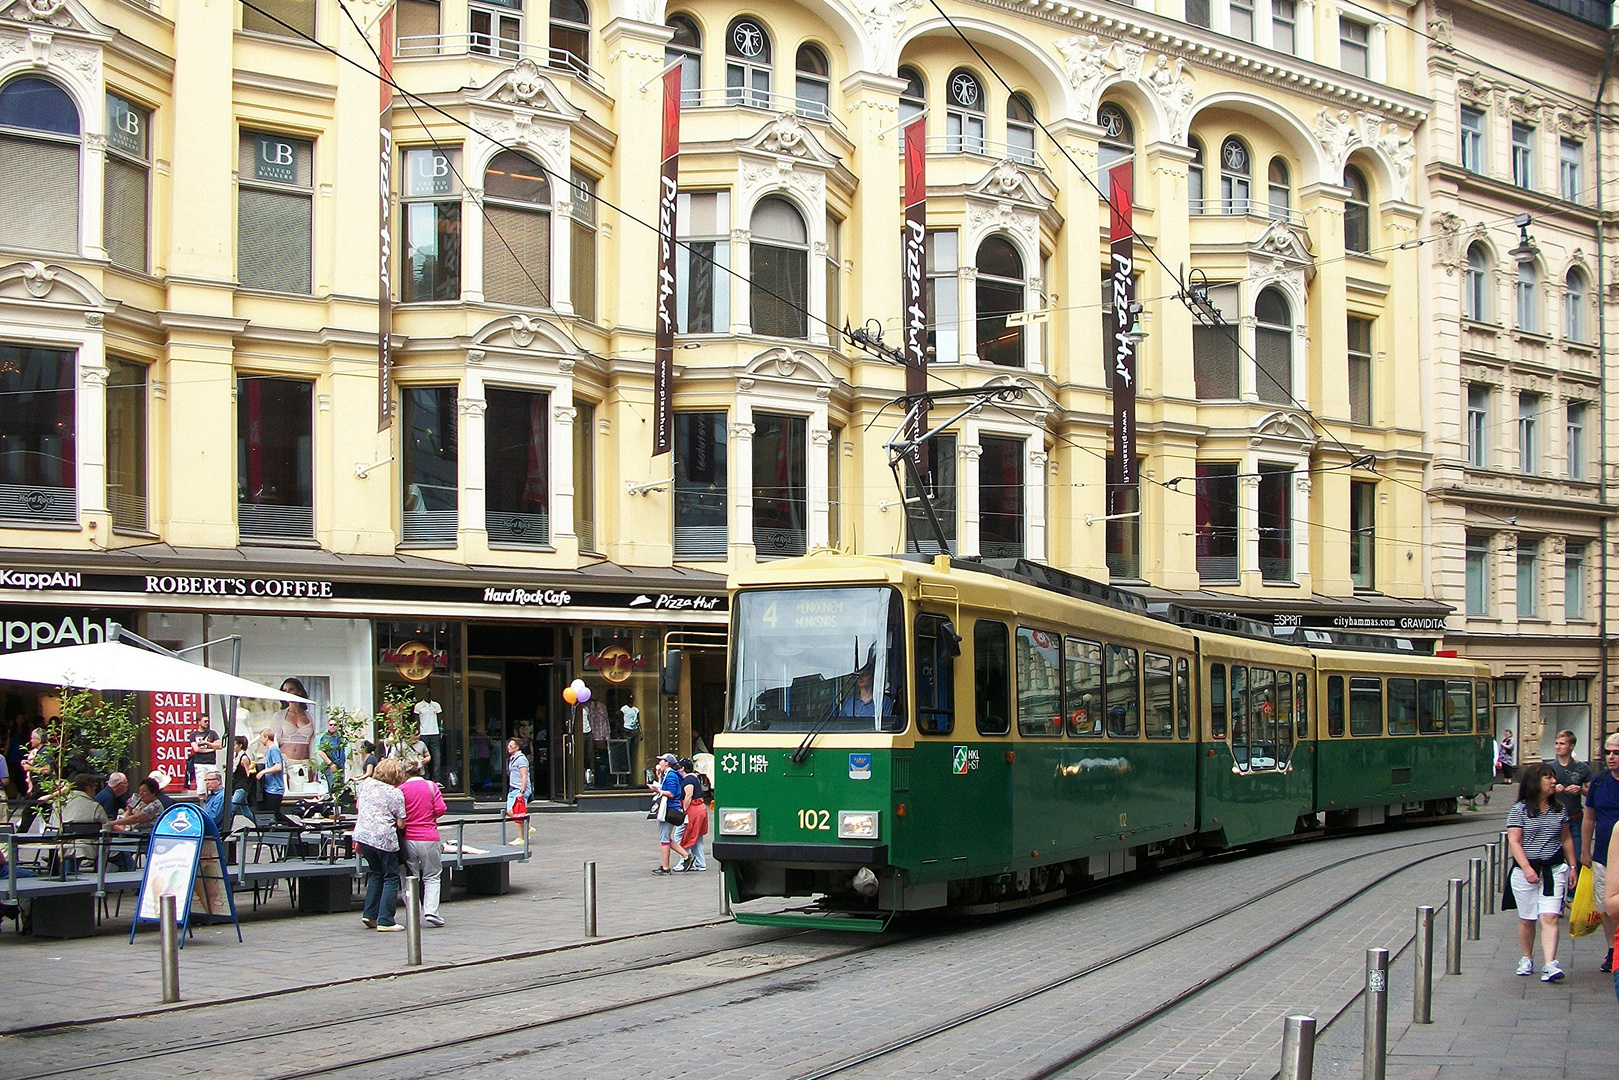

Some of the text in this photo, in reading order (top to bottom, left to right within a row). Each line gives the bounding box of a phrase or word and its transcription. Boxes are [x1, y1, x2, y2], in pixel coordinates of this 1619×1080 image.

[260, 140, 294, 166] UB
[258, 170, 292, 180] BANKERS
[261, 166, 290, 174] UNITED
[380, 127, 391, 298] Pizza Hut
[659, 176, 677, 334] Pizza Hut
[906, 220, 926, 366] Pizza Hut
[1112, 253, 1134, 388] Pizza Hut
[0, 570, 81, 590] KappAhl
[145, 576, 333, 598] ROBERT'S COFFEE
[484, 588, 571, 606] Hard Rock Cafe
[655, 594, 720, 610] Pizza Hut
[762, 600, 778, 629] 4
[1274, 614, 1302, 626] ESPRIT
[1334, 616, 1396, 628] cityhammas.com
[0, 616, 112, 650] ppAhl
[154, 693, 196, 707] SALE!
[156, 710, 197, 724] SALE!
[749, 754, 768, 764] HSL
[968, 750, 980, 760] HKL
[158, 764, 187, 778] SAL
[749, 764, 768, 773] HRT
[968, 760, 979, 770] HST
[798, 809, 830, 830] 102
